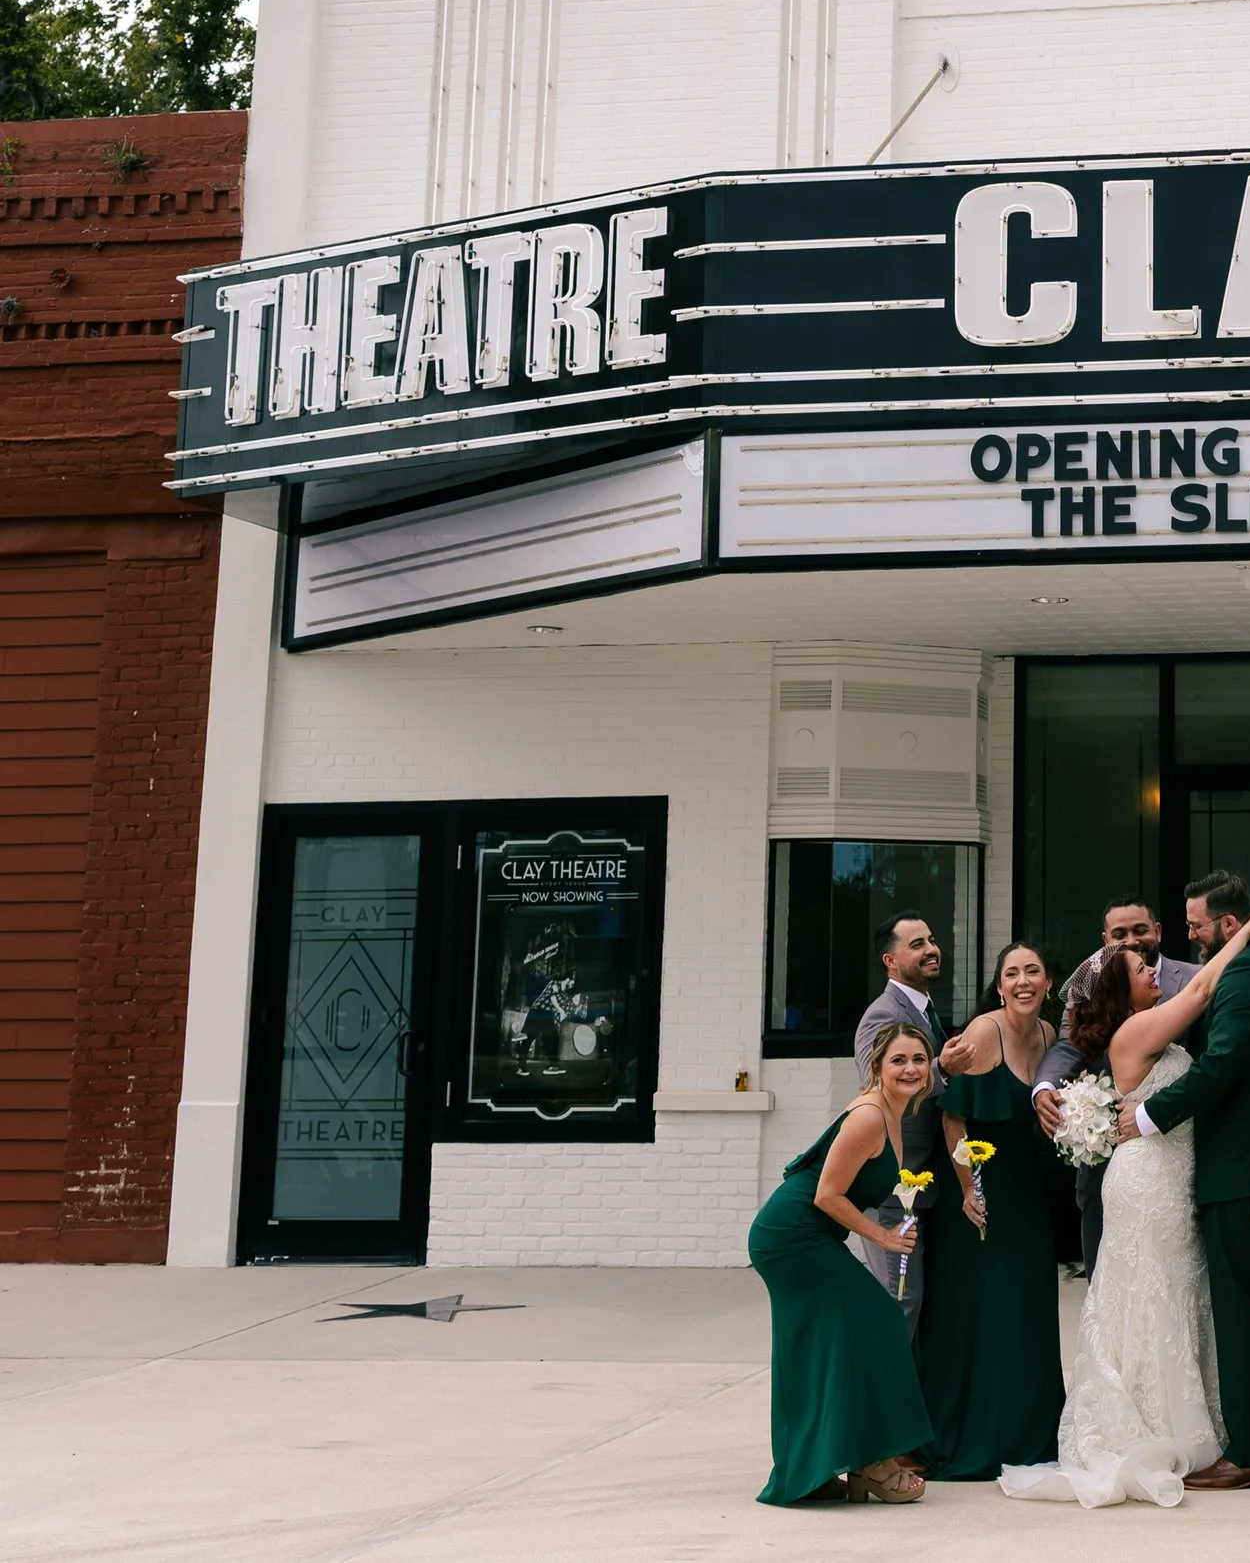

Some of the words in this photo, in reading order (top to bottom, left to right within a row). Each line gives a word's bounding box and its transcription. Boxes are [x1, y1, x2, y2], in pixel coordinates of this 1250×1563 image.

[215, 206, 669, 426] THEATRE
[969, 427, 1240, 483] OPENING
[1021, 485, 1137, 537] THE
[501, 861, 545, 880] CLAY
[550, 860, 627, 879] THEATRE
[522, 892, 549, 903] NOW
[553, 891, 604, 902] SHOWING
[321, 905, 386, 923] CLAY
[279, 1120, 404, 1141] THEATRE
